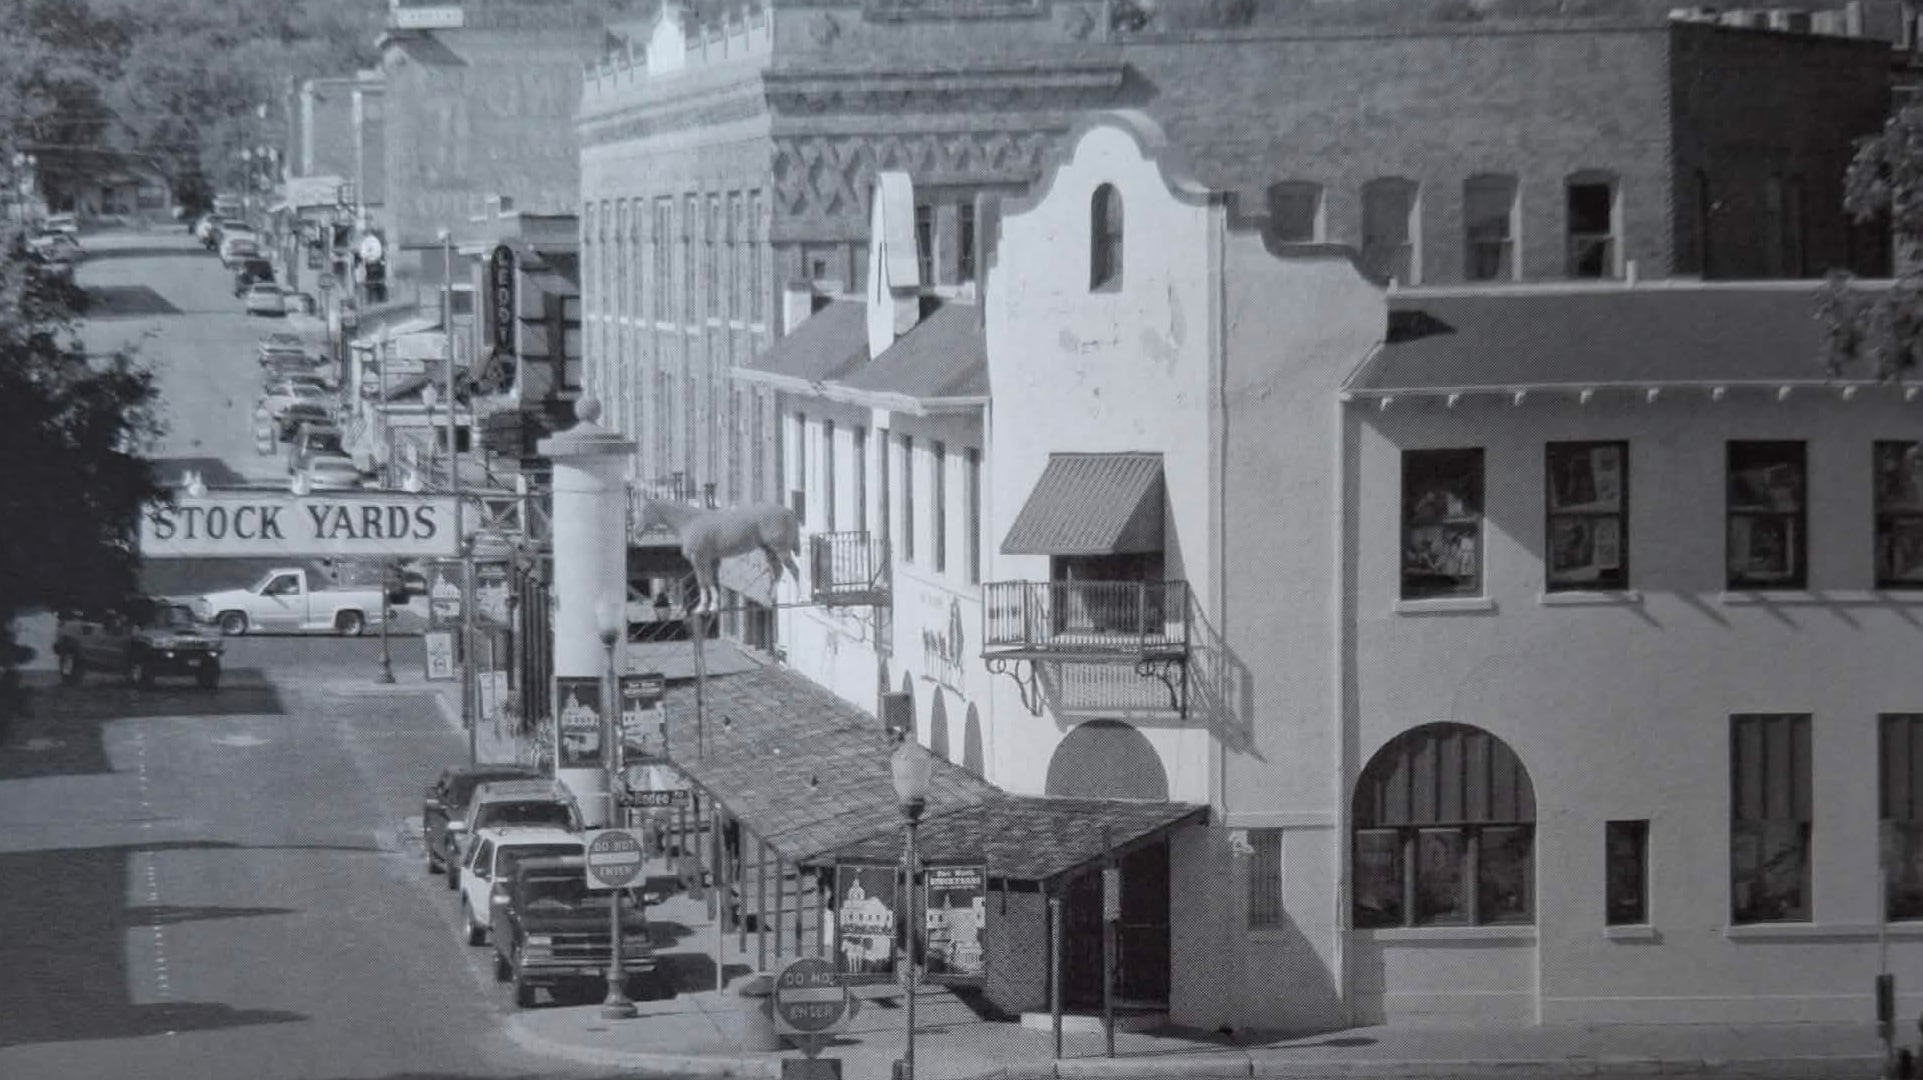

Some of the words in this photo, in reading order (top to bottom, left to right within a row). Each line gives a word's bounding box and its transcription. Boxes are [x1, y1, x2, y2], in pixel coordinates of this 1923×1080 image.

[153, 504, 286, 540] STOCK
[306, 504, 437, 540] YARDS
[594, 841, 609, 852] DO
[785, 972, 804, 986] DO
